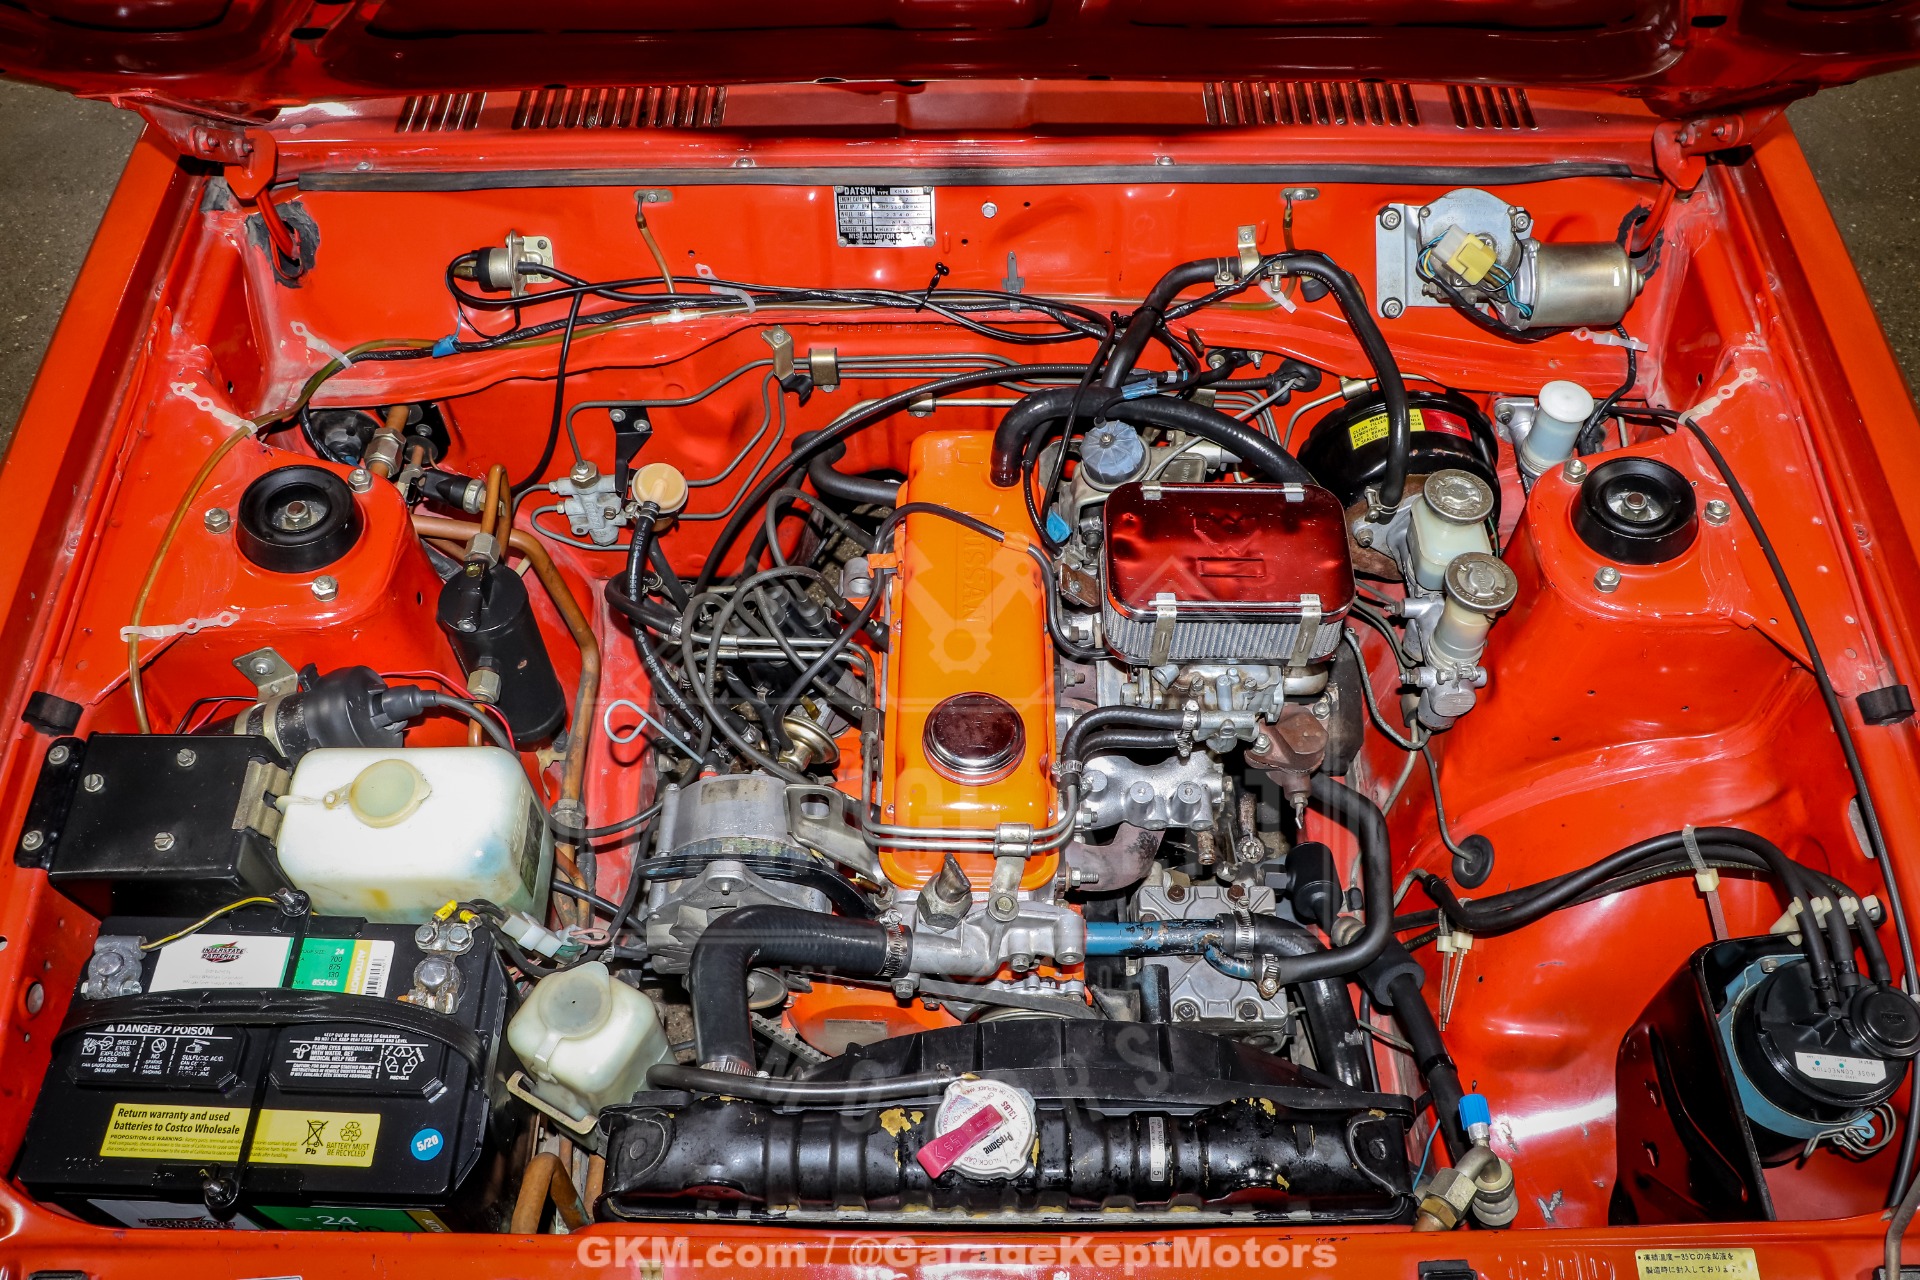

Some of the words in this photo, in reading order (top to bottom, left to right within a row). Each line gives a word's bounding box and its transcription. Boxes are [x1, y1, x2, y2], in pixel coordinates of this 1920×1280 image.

[844, 187, 876, 196] DATSUN
[848, 232, 873, 240] NISSAN
[874, 232, 896, 240] MOTOR
[963, 529, 986, 623] NISSAN
[334, 948, 345, 956] 24
[312, 978, 338, 987] 852163
[116, 1024, 162, 1034] DANGER
[172, 1026, 214, 1036] POISON
[1812, 1066, 1854, 1076] CONNECTION
[118, 1108, 148, 1118] Return
[149, 1110, 188, 1122] warranty
[190, 1111, 207, 1120] and
[209, 1112, 230, 1122] used
[1000, 1100, 1017, 1120] 13LBS
[114, 1122, 152, 1132] batteries
[154, 1123, 163, 1132] to
[164, 1123, 193, 1133] Costco
[194, 1124, 240, 1135] Wholesale
[416, 1134, 439, 1152] 5/20
[944, 1141, 954, 1152] UP
[950, 1134, 964, 1148] LIFT
[983, 1132, 1014, 1155] Prestone
[352, 1143, 370, 1151] MUST
[336, 1150, 366, 1158] RECYCLED
[316, 1215, 359, 1225] 24
